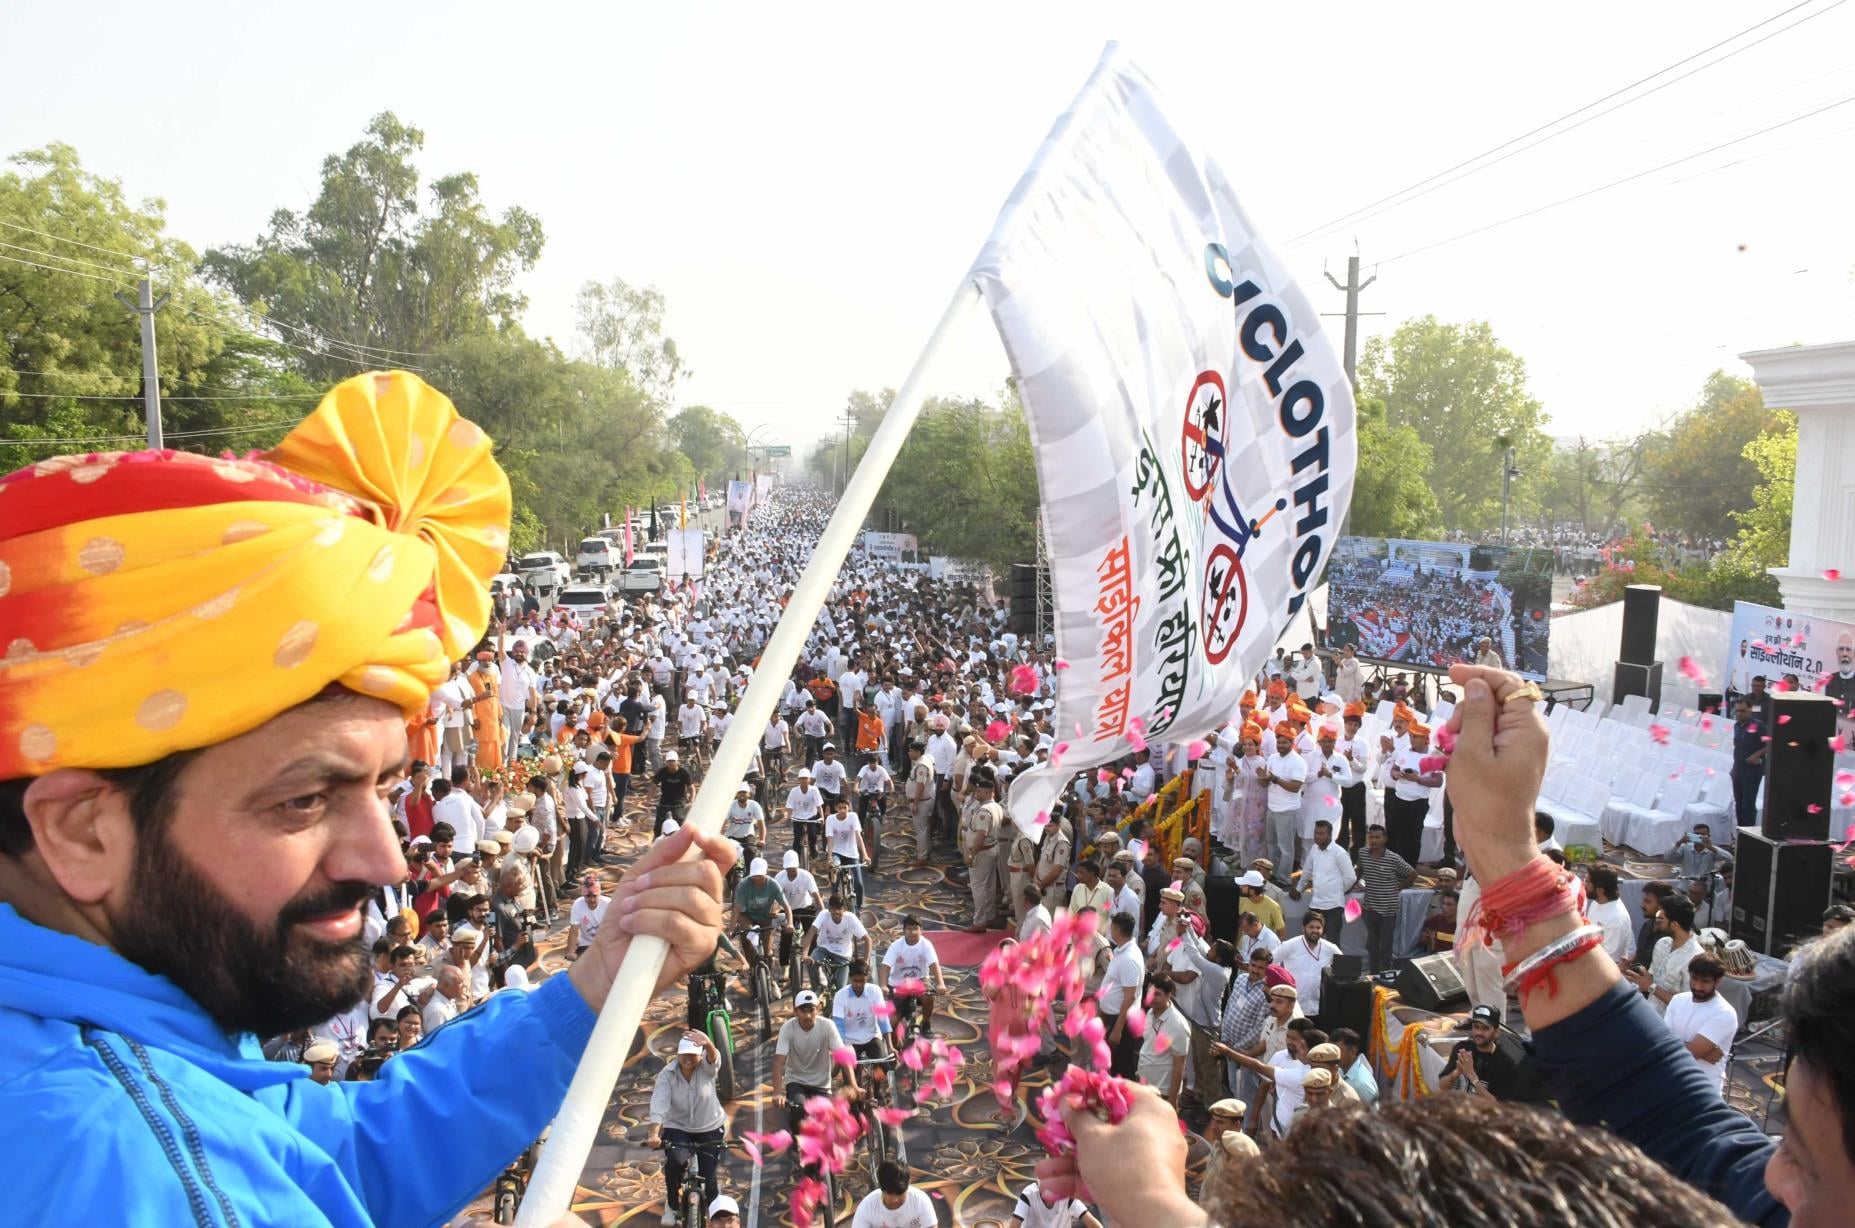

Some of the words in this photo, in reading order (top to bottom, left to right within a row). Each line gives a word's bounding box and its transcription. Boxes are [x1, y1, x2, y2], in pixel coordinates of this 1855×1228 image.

[1093, 535, 1141, 682] साइकिल
[1093, 677, 1131, 742] यात्रा
[1143, 597, 1197, 741] हरियाण
[1805, 657, 1823, 674] 2.0
